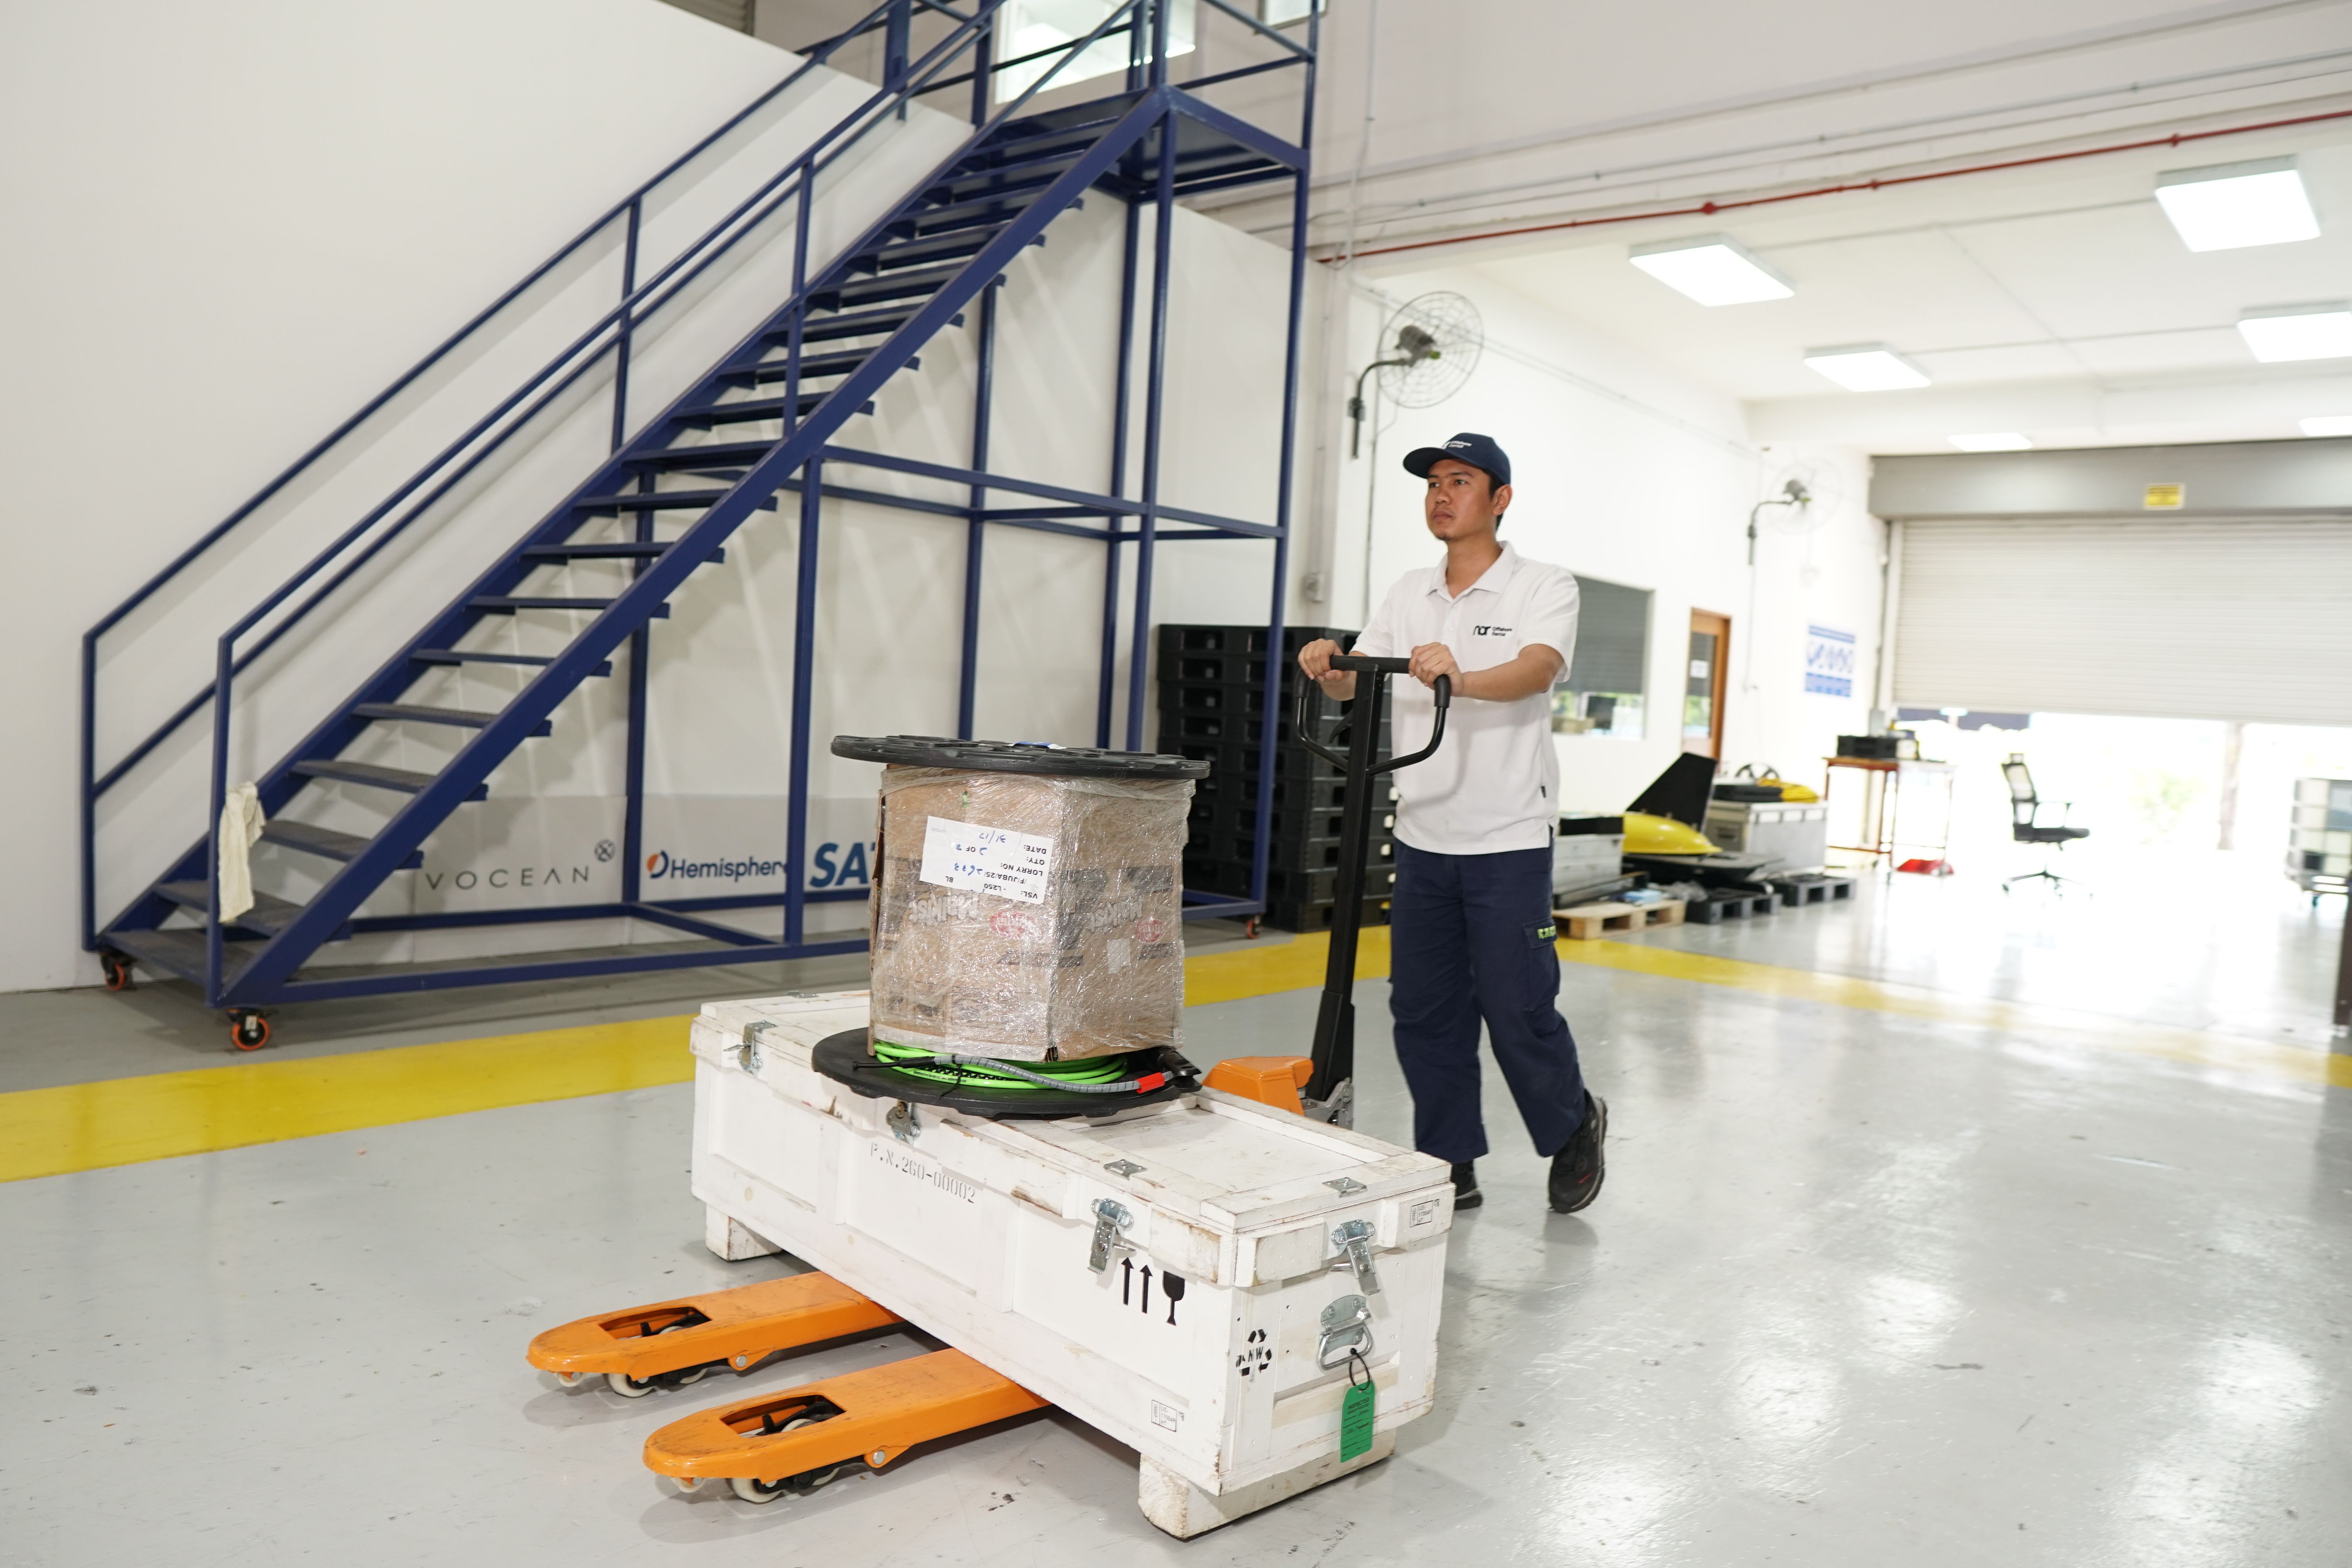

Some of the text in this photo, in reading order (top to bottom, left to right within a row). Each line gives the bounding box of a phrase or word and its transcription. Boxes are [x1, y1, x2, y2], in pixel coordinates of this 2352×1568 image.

[1024, 844, 1047, 854] DATE:
[809, 842, 877, 888] SA
[1026, 857, 1045, 865] QTY:
[670, 856, 788, 883] Hemispher
[1016, 867, 1043, 877] LORRY
[426, 866, 589, 890] VOCEAN
[1021, 890, 1038, 899] VSL:
[1161, 1413, 1175, 1423] 17004P
